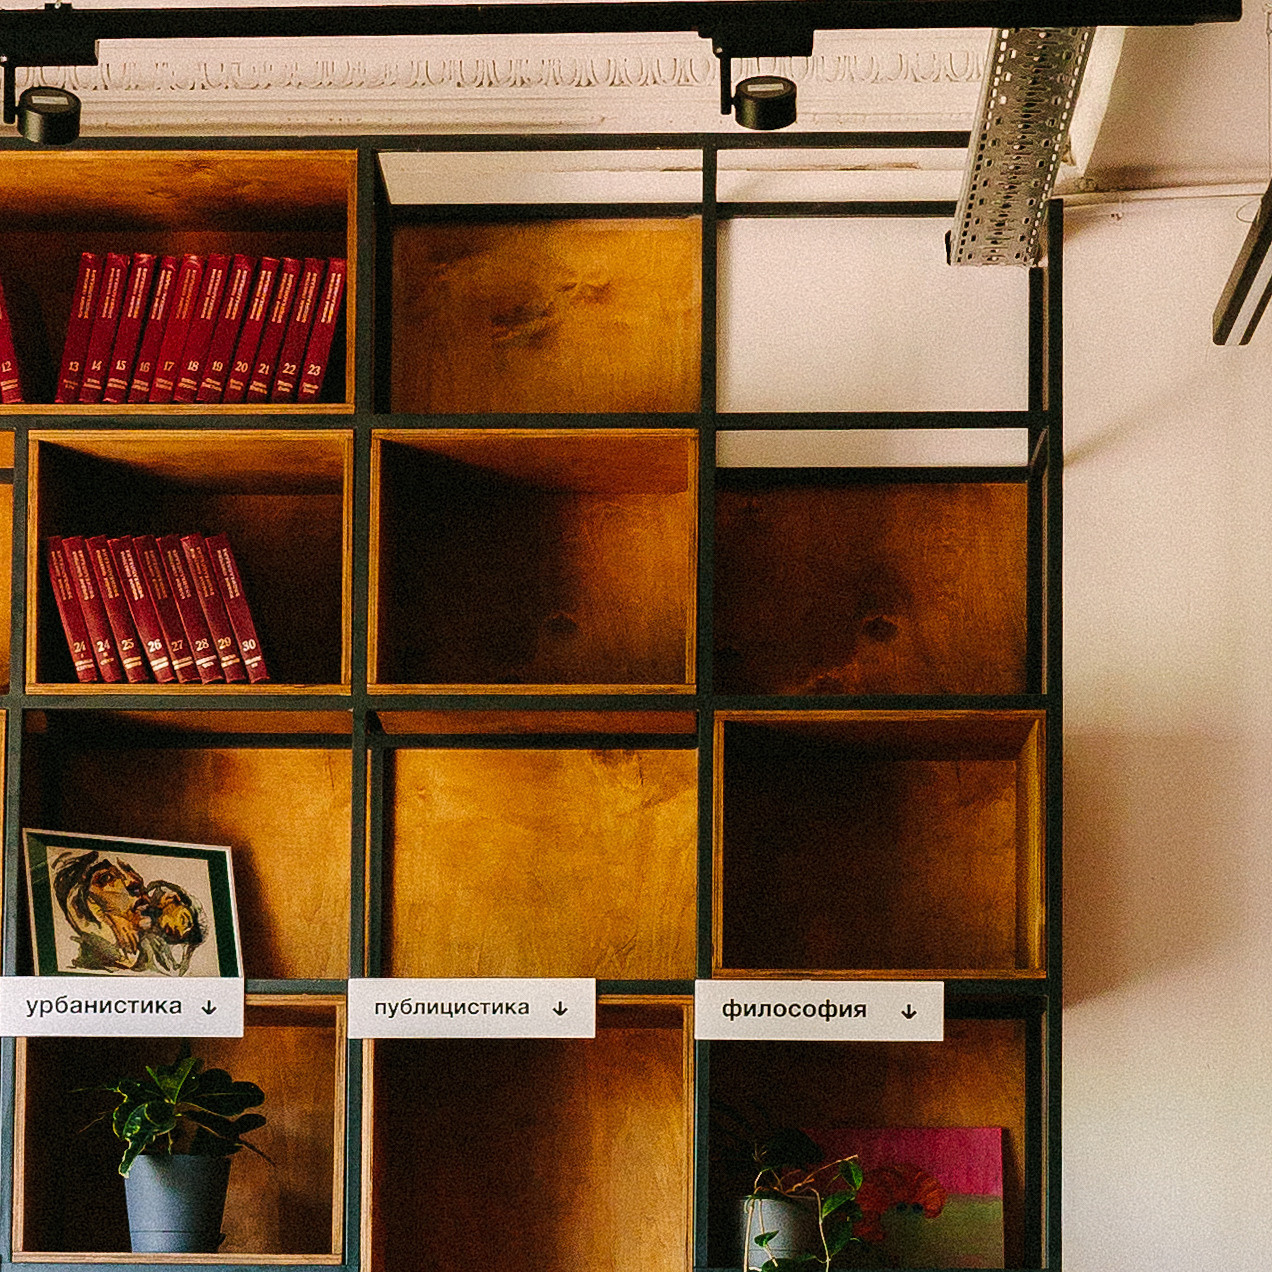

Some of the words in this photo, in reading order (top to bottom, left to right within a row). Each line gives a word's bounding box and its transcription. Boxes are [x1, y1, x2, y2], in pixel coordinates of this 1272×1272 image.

[0, 360, 12, 373] 12
[68, 361, 79, 372] 13
[91, 360, 102, 371] 14
[115, 360, 127, 371] 15
[139, 361, 150, 373] 16
[163, 361, 175, 372] 17
[187, 360, 199, 372] 18
[212, 360, 223, 372] 19
[234, 360, 249, 373] 20
[282, 362, 296, 375] 22
[308, 363, 321, 376] 23
[121, 638, 135, 650] 25
[147, 639, 162, 653] 26
[195, 638, 210, 652] 28
[242, 638, 256, 651] 30
[25, 994, 183, 1019] урбанистика
[374, 995, 530, 1019] публицистика
[721, 997, 868, 1022] философия
